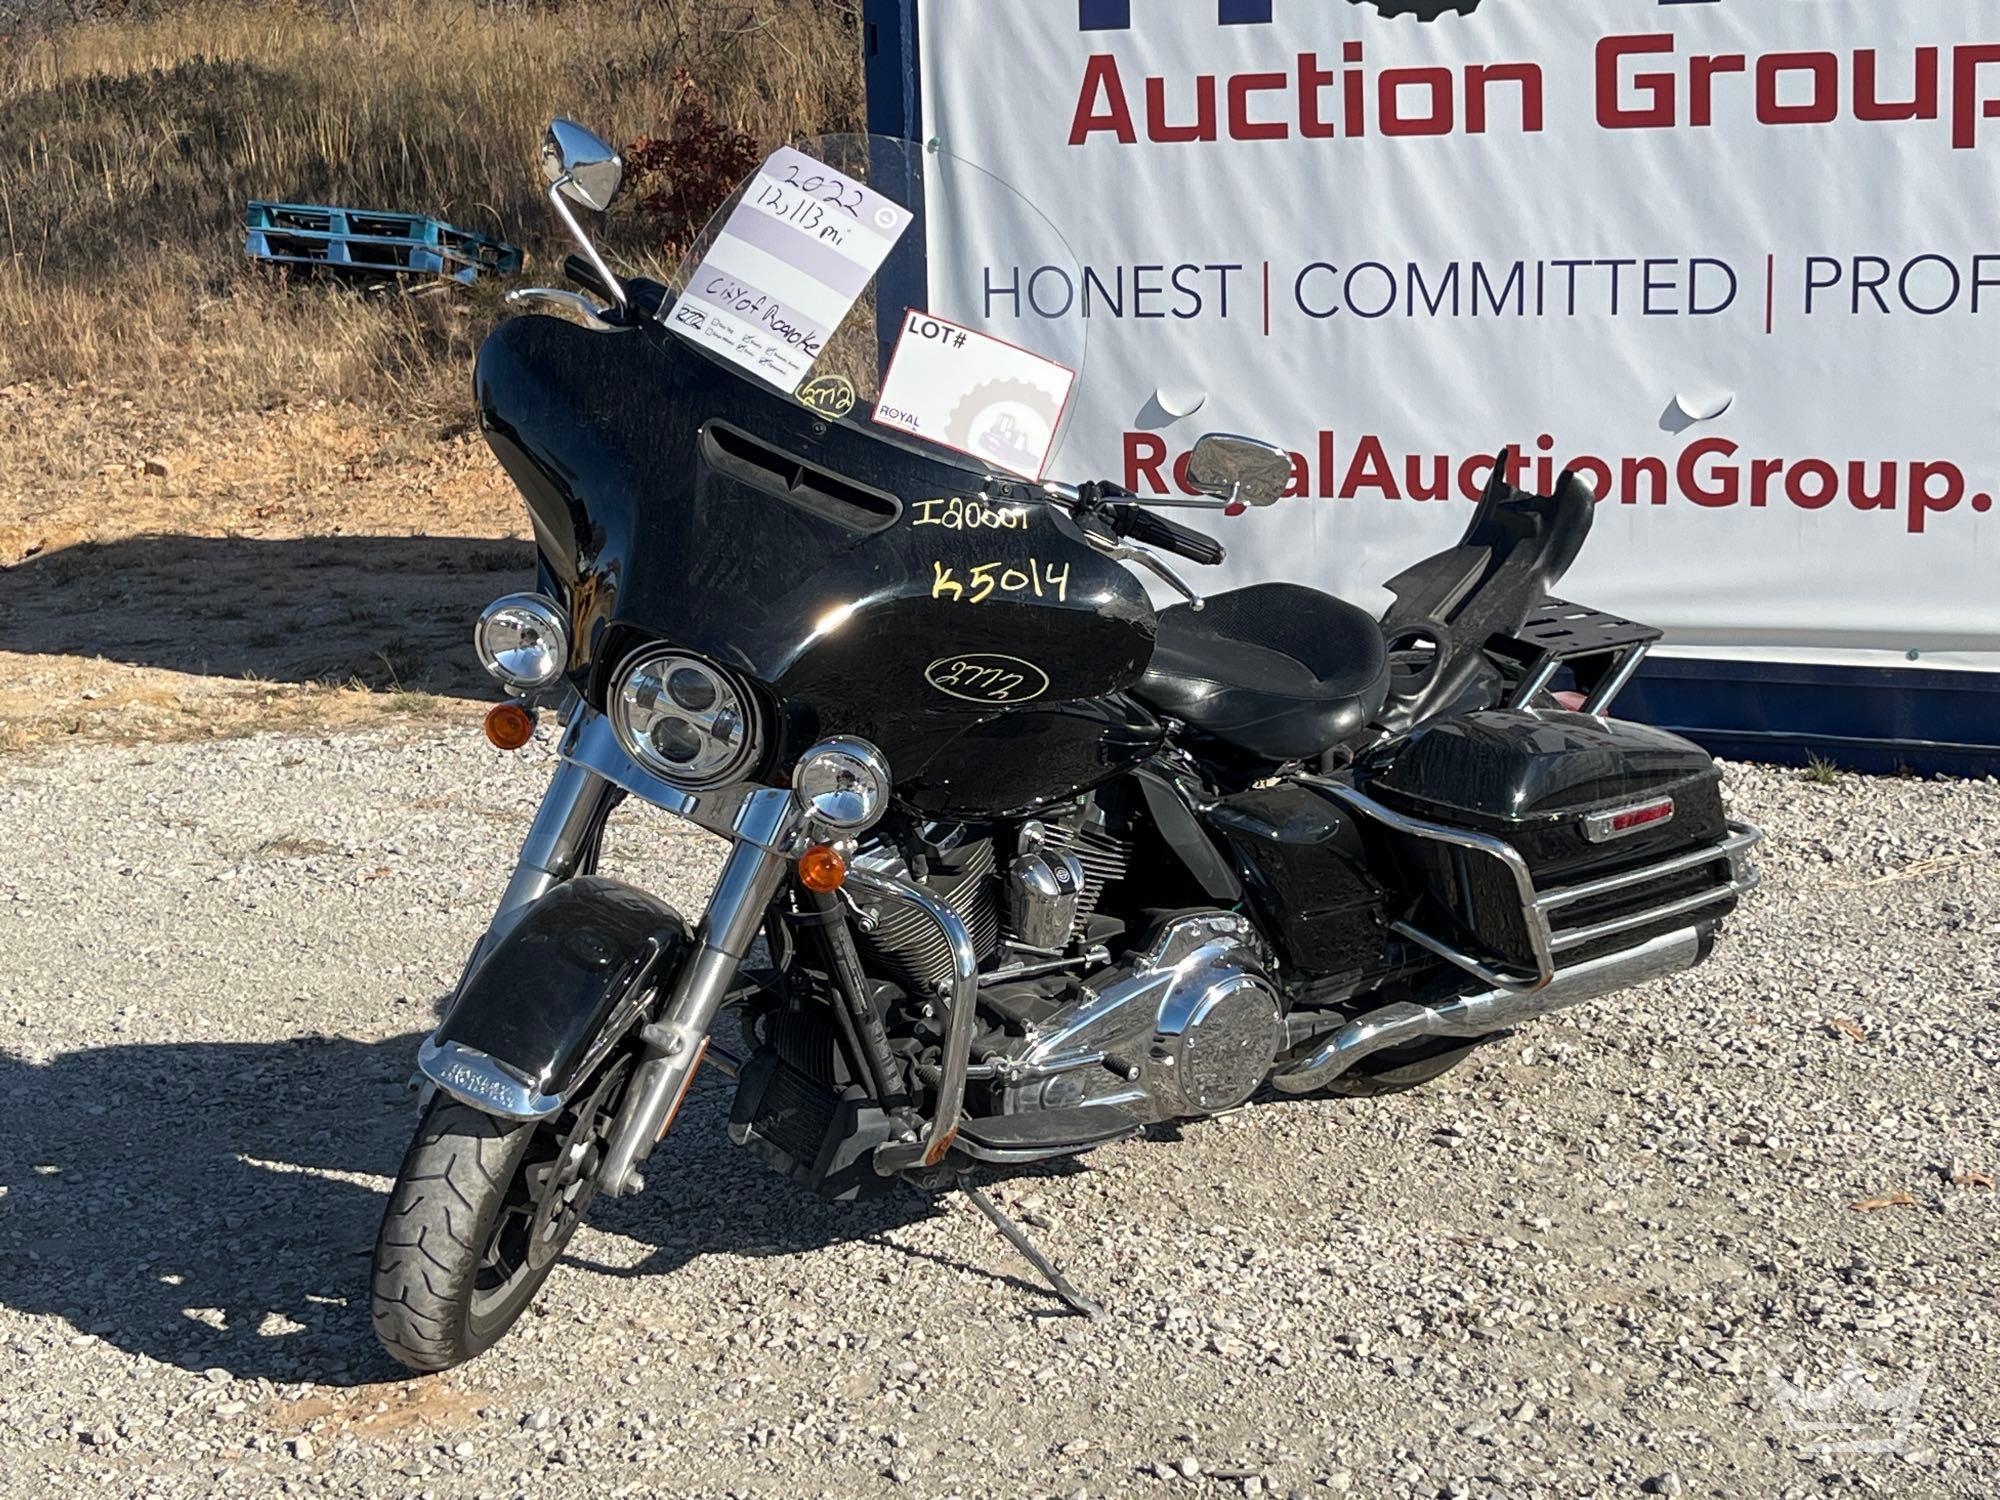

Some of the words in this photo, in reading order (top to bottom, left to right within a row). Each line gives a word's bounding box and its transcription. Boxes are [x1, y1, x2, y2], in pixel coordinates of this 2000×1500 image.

[1068, 41, 1543, 145] Auction
[1595, 33, 2000, 149] Group
[757, 185, 824, 229] 12,113
[819, 225, 851, 246] mi
[785, 165, 863, 217] 2022
[984, 262, 1243, 319] HONEST
[1294, 257, 1738, 319] COMMITTED
[1804, 254, 2000, 315] PROF
[908, 316, 967, 349] LOT#
[880, 405, 920, 427] ROYAL
[1123, 430, 1993, 533] RalAuctionGroup.
[932, 557, 1069, 603] K5014
[935, 661, 1024, 699] 2772
